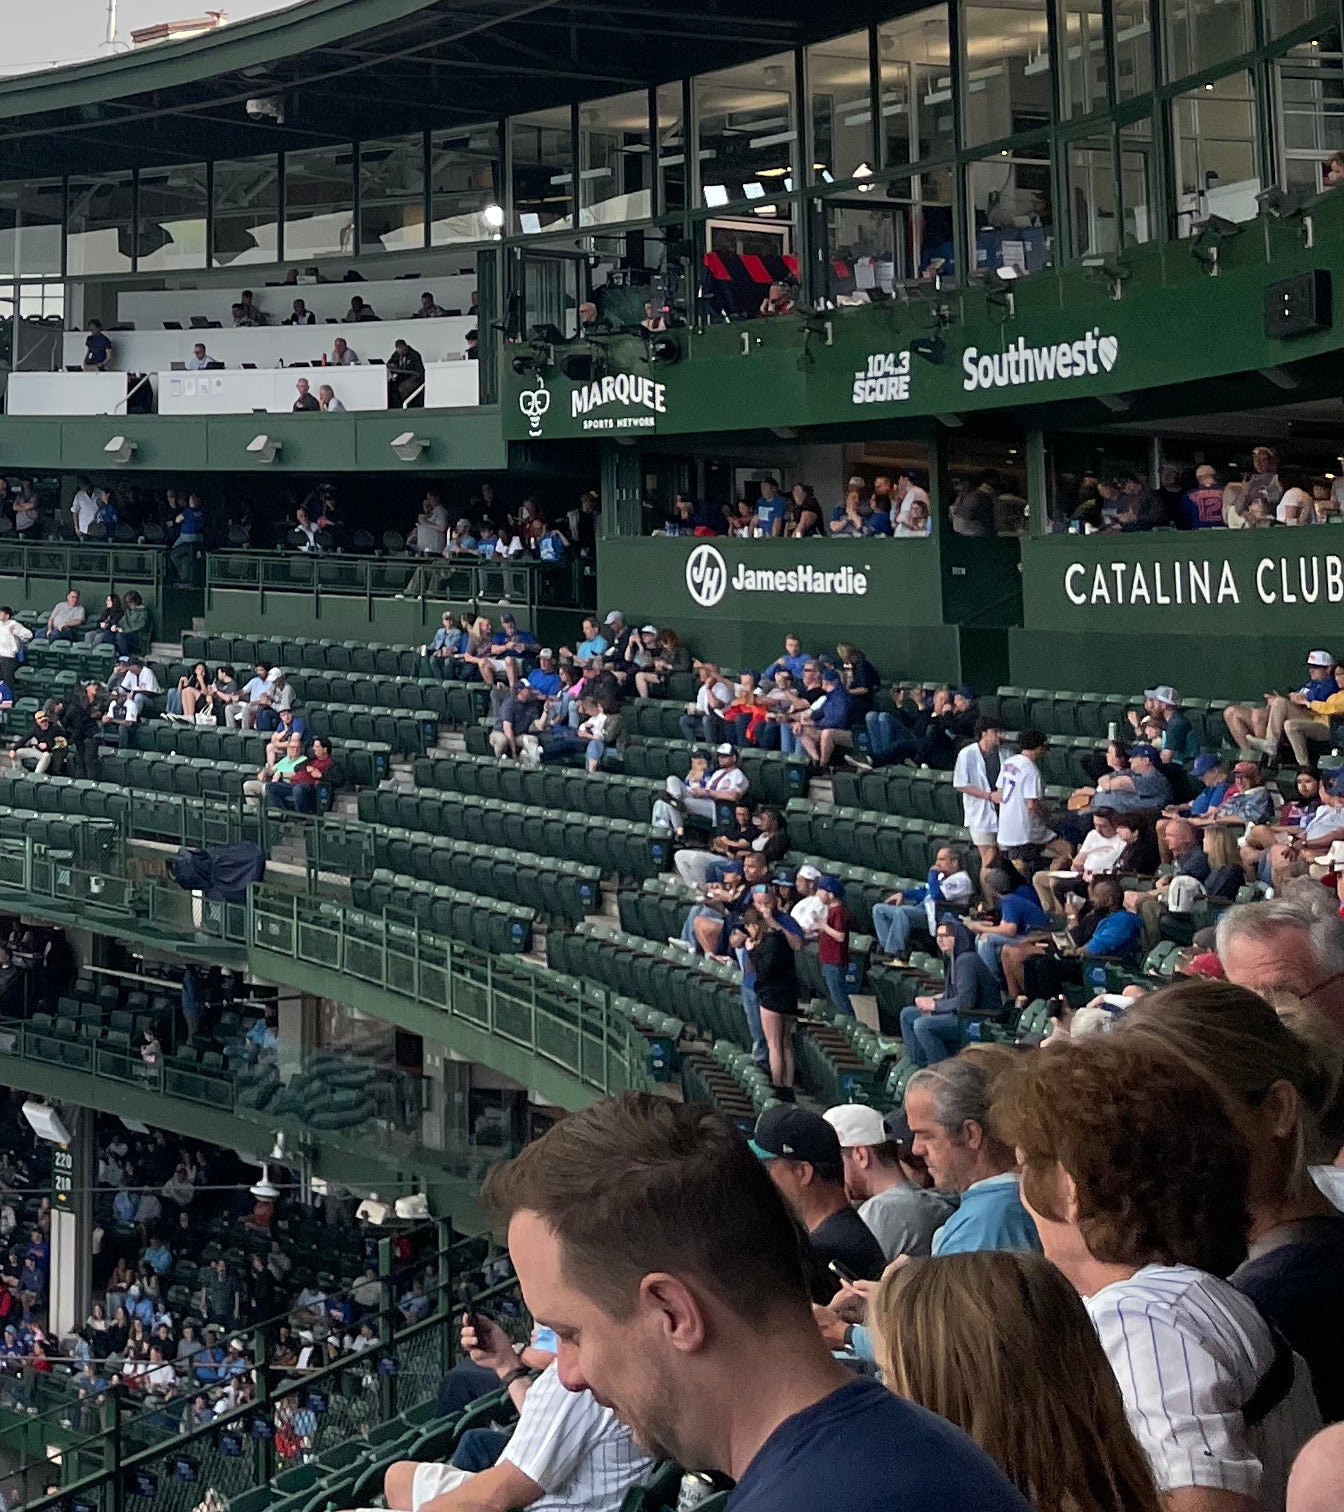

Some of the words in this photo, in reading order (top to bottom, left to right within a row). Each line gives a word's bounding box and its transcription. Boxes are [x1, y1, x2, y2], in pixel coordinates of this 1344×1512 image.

[867, 351, 911, 377] 104.3
[963, 331, 1099, 391] Southwest
[572, 373, 667, 418] MARQUEE
[853, 375, 911, 404] SCORE
[583, 418, 614, 430] SPORTS
[617, 416, 655, 427] NETWORK
[732, 563, 868, 595] JamesHardie
[1064, 560, 1240, 605] CATALINA
[1256, 555, 1344, 604] CLUB
[55, 1151, 72, 1169] 220
